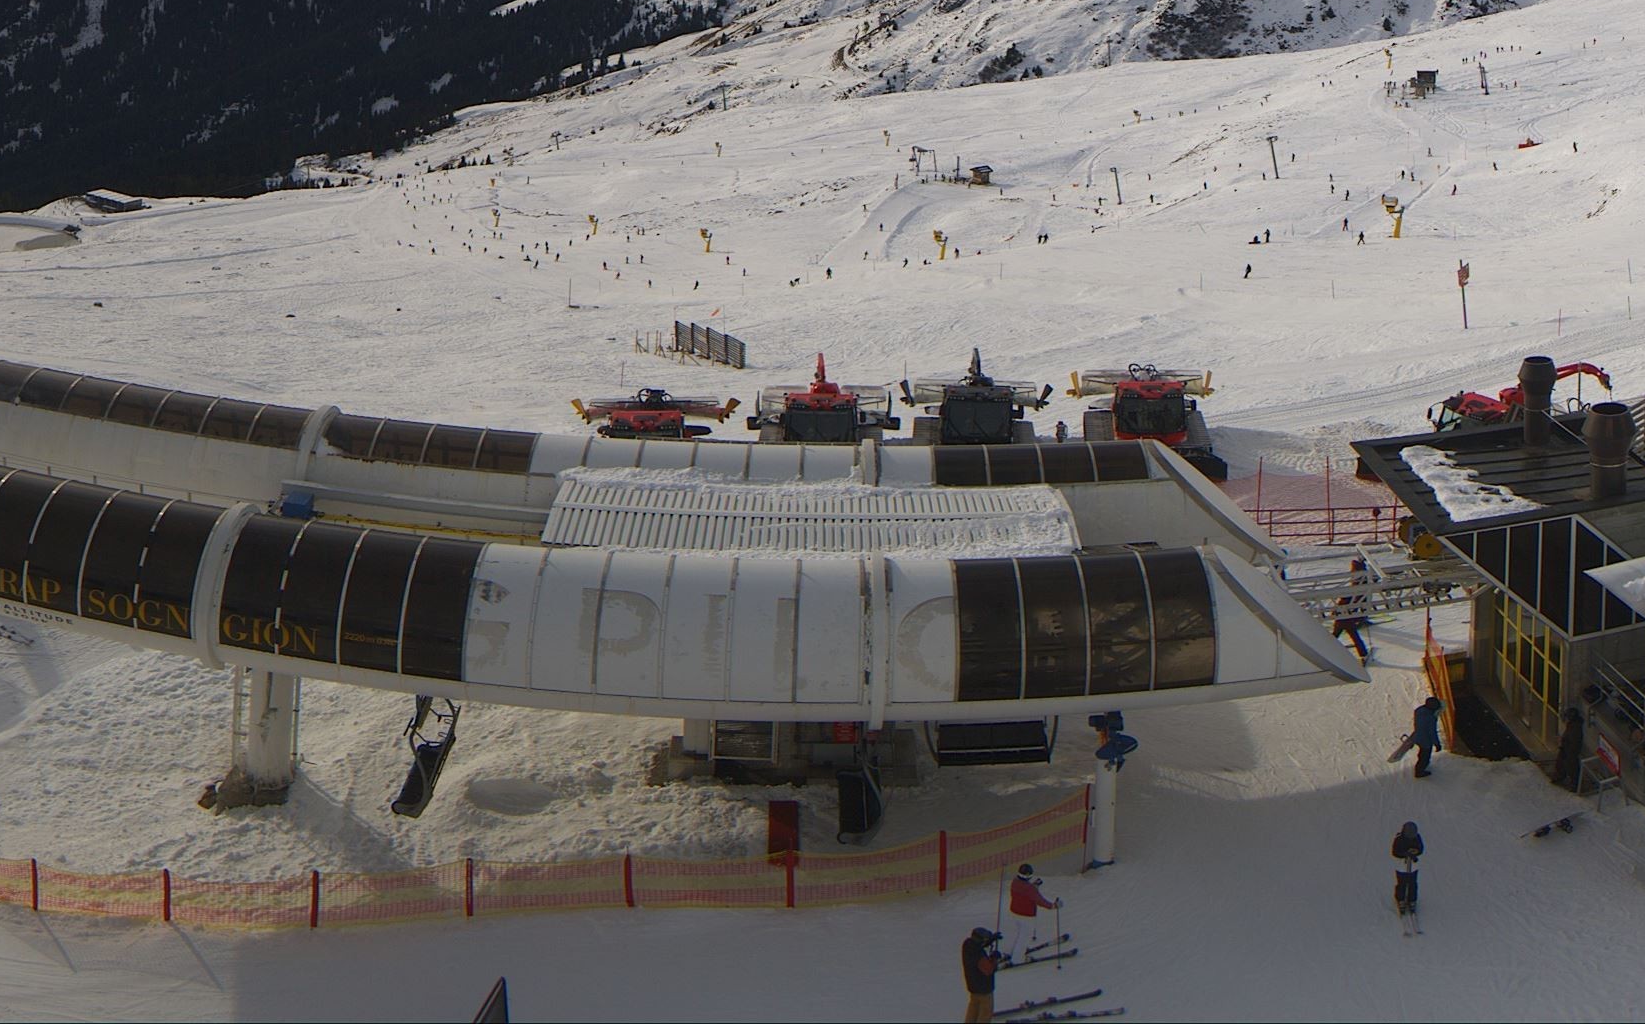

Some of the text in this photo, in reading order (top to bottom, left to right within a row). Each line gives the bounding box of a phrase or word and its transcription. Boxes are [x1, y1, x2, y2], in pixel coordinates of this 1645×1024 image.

[4, 604, 74, 625] ALTITUDE
[88, 589, 191, 632] SOGN
[222, 614, 319, 654] GION
